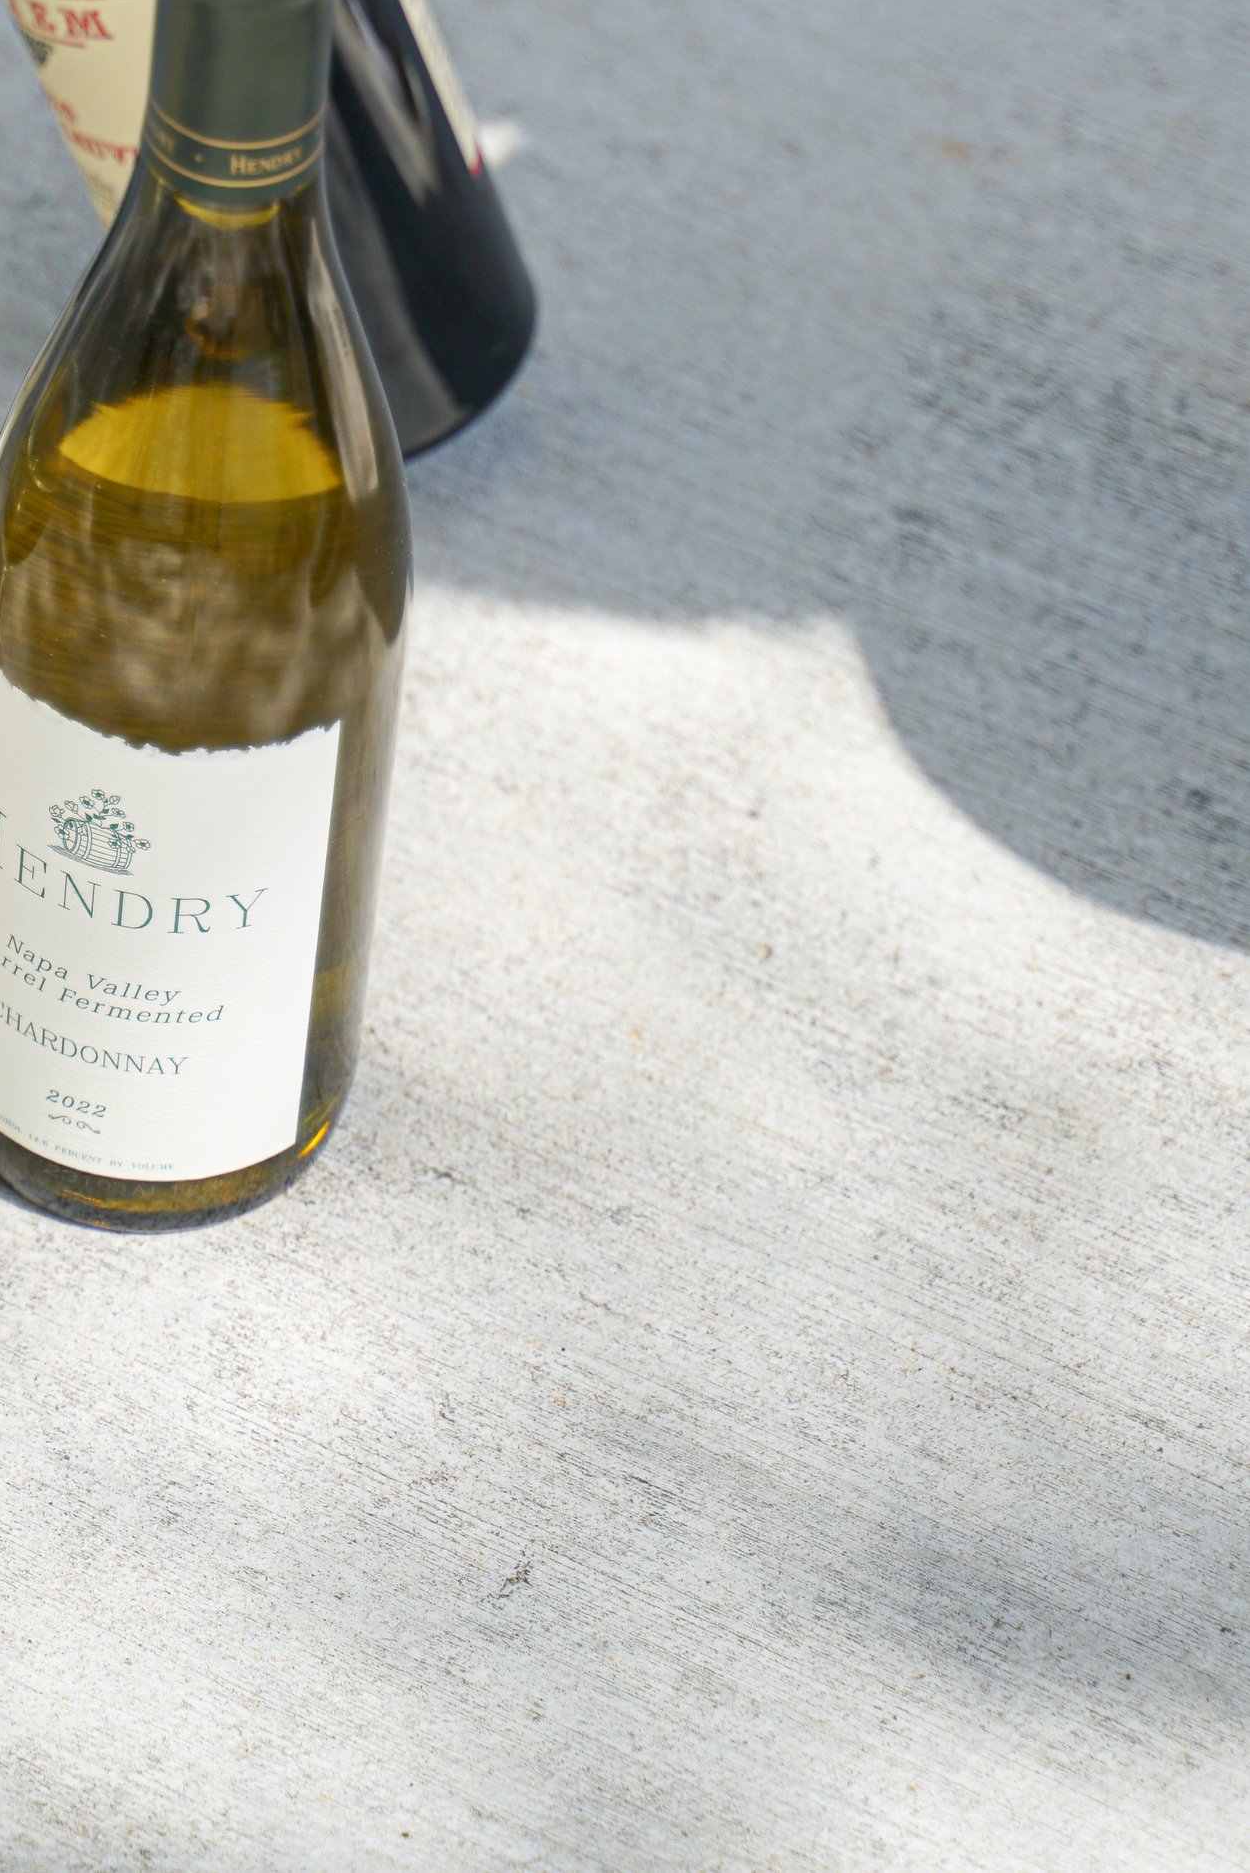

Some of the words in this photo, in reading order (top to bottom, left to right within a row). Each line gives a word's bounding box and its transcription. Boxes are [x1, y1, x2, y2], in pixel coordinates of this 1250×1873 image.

[5, 933, 69, 981] Napa
[86, 972, 182, 1007] Valley
[57, 986, 225, 1024] Fermented
[46, 1089, 107, 1119] 2022
[54, 1144, 103, 1165] PERCENT
[109, 1159, 124, 1168] BY
[131, 1162, 175, 1171] VOLUME
